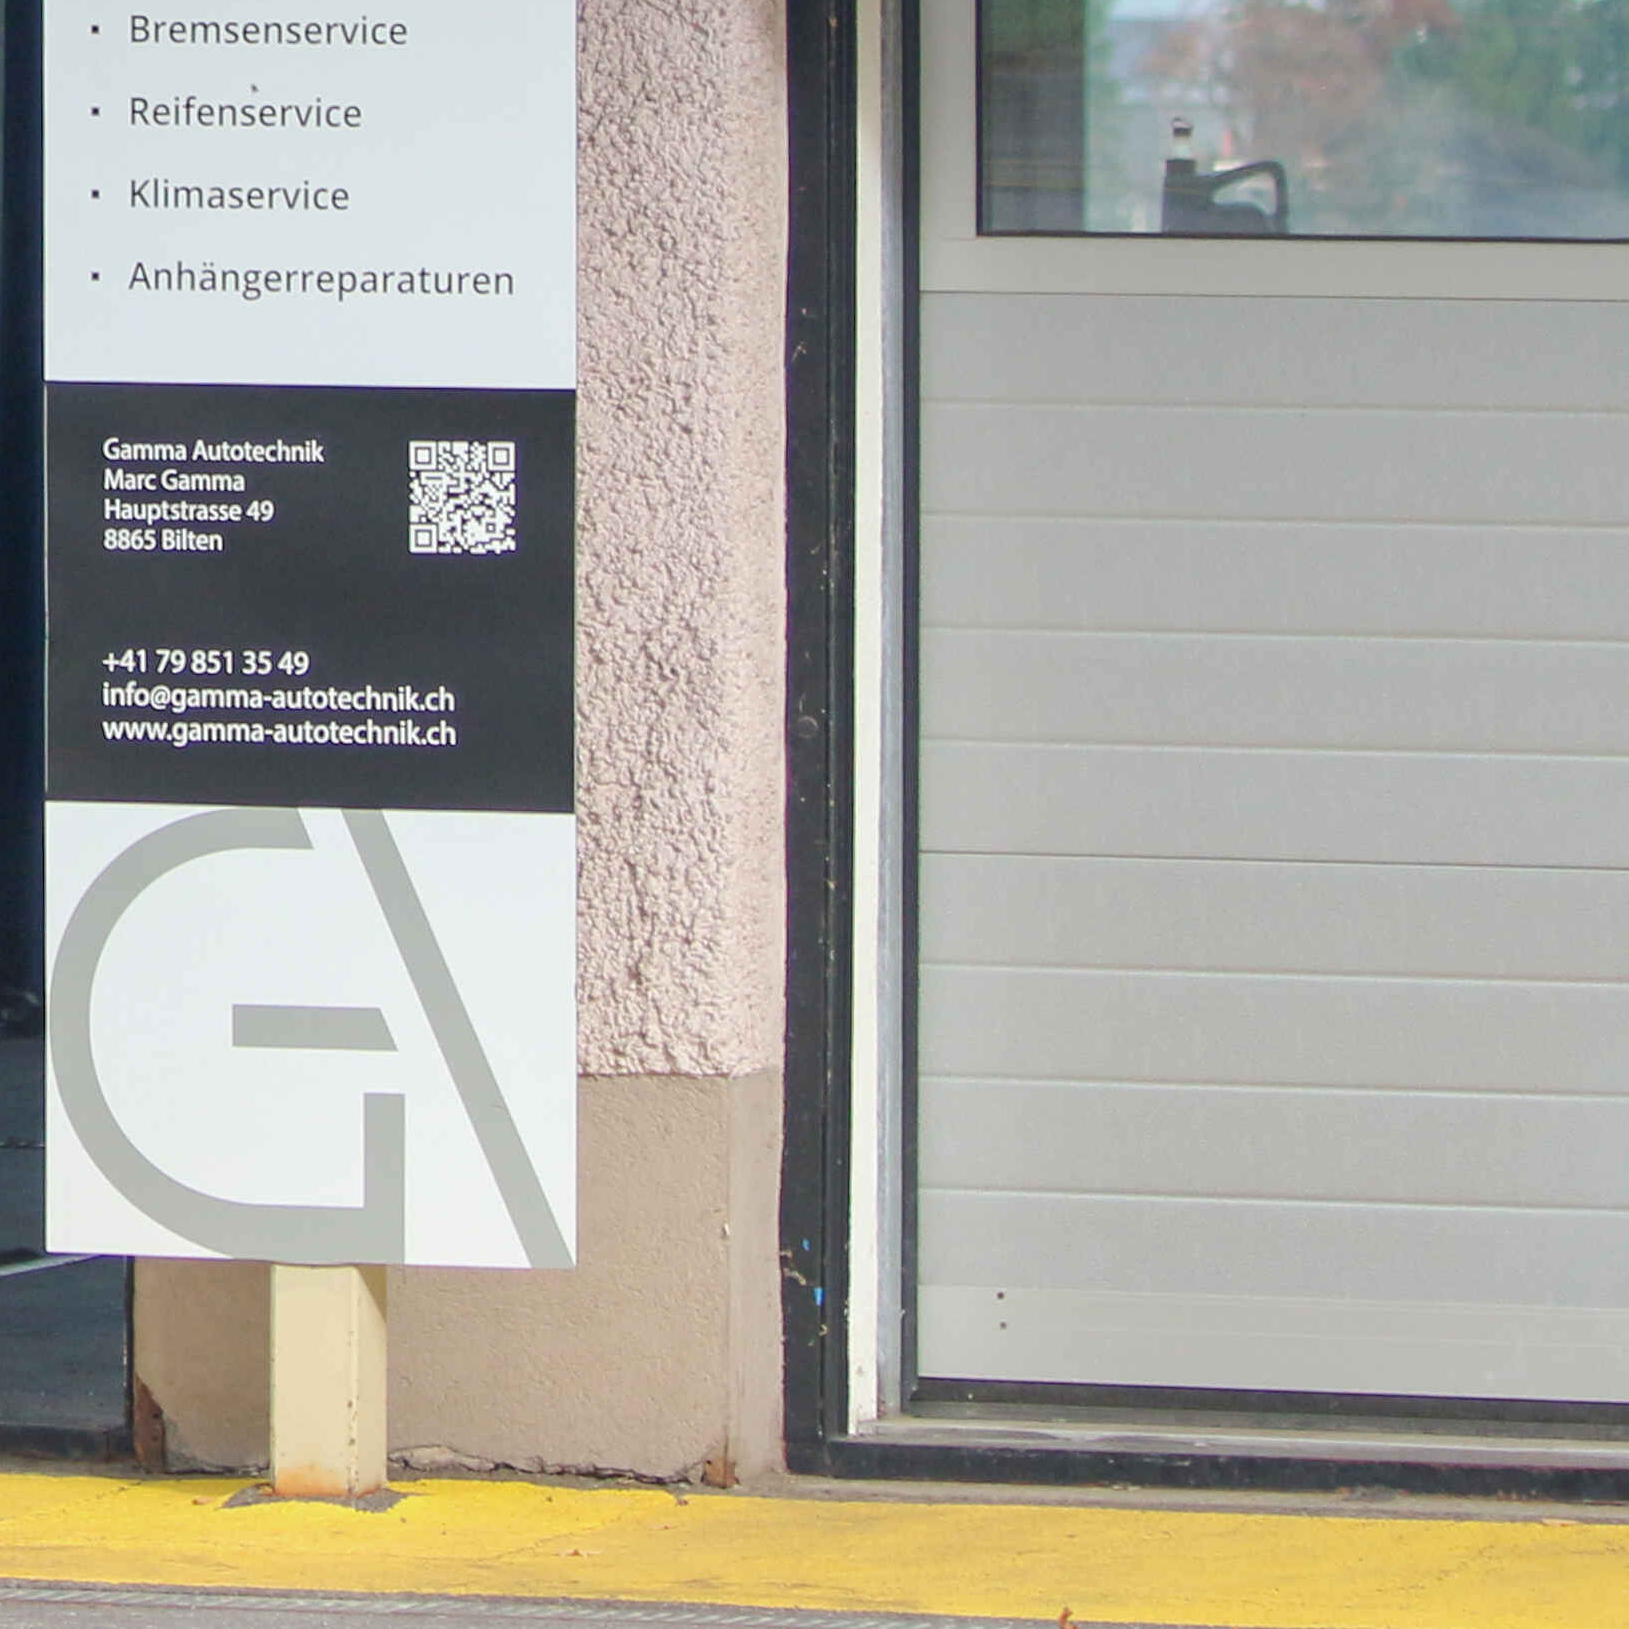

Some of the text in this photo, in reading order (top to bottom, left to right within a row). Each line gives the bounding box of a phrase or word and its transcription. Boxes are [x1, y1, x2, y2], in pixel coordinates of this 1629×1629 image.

[130, 14, 408, 45] Bremsenservice
[130, 95, 362, 128] Reifenservice
[130, 178, 349, 211] Klimaservice
[128, 260, 513, 302] Anhängerreparaturen
[102, 437, 325, 463] Gamma Autotechnik
[103, 467, 245, 492] Marc Gamma
[104, 498, 275, 526] Hauptstrasse 49
[103, 528, 223, 551] 8865 Bilten
[102, 648, 310, 676] +41 79 851 35 49
[102, 680, 455, 714] info@gamma-autotechnik.ch
[102, 718, 457, 748] www.gamma-autotechnik.ch
